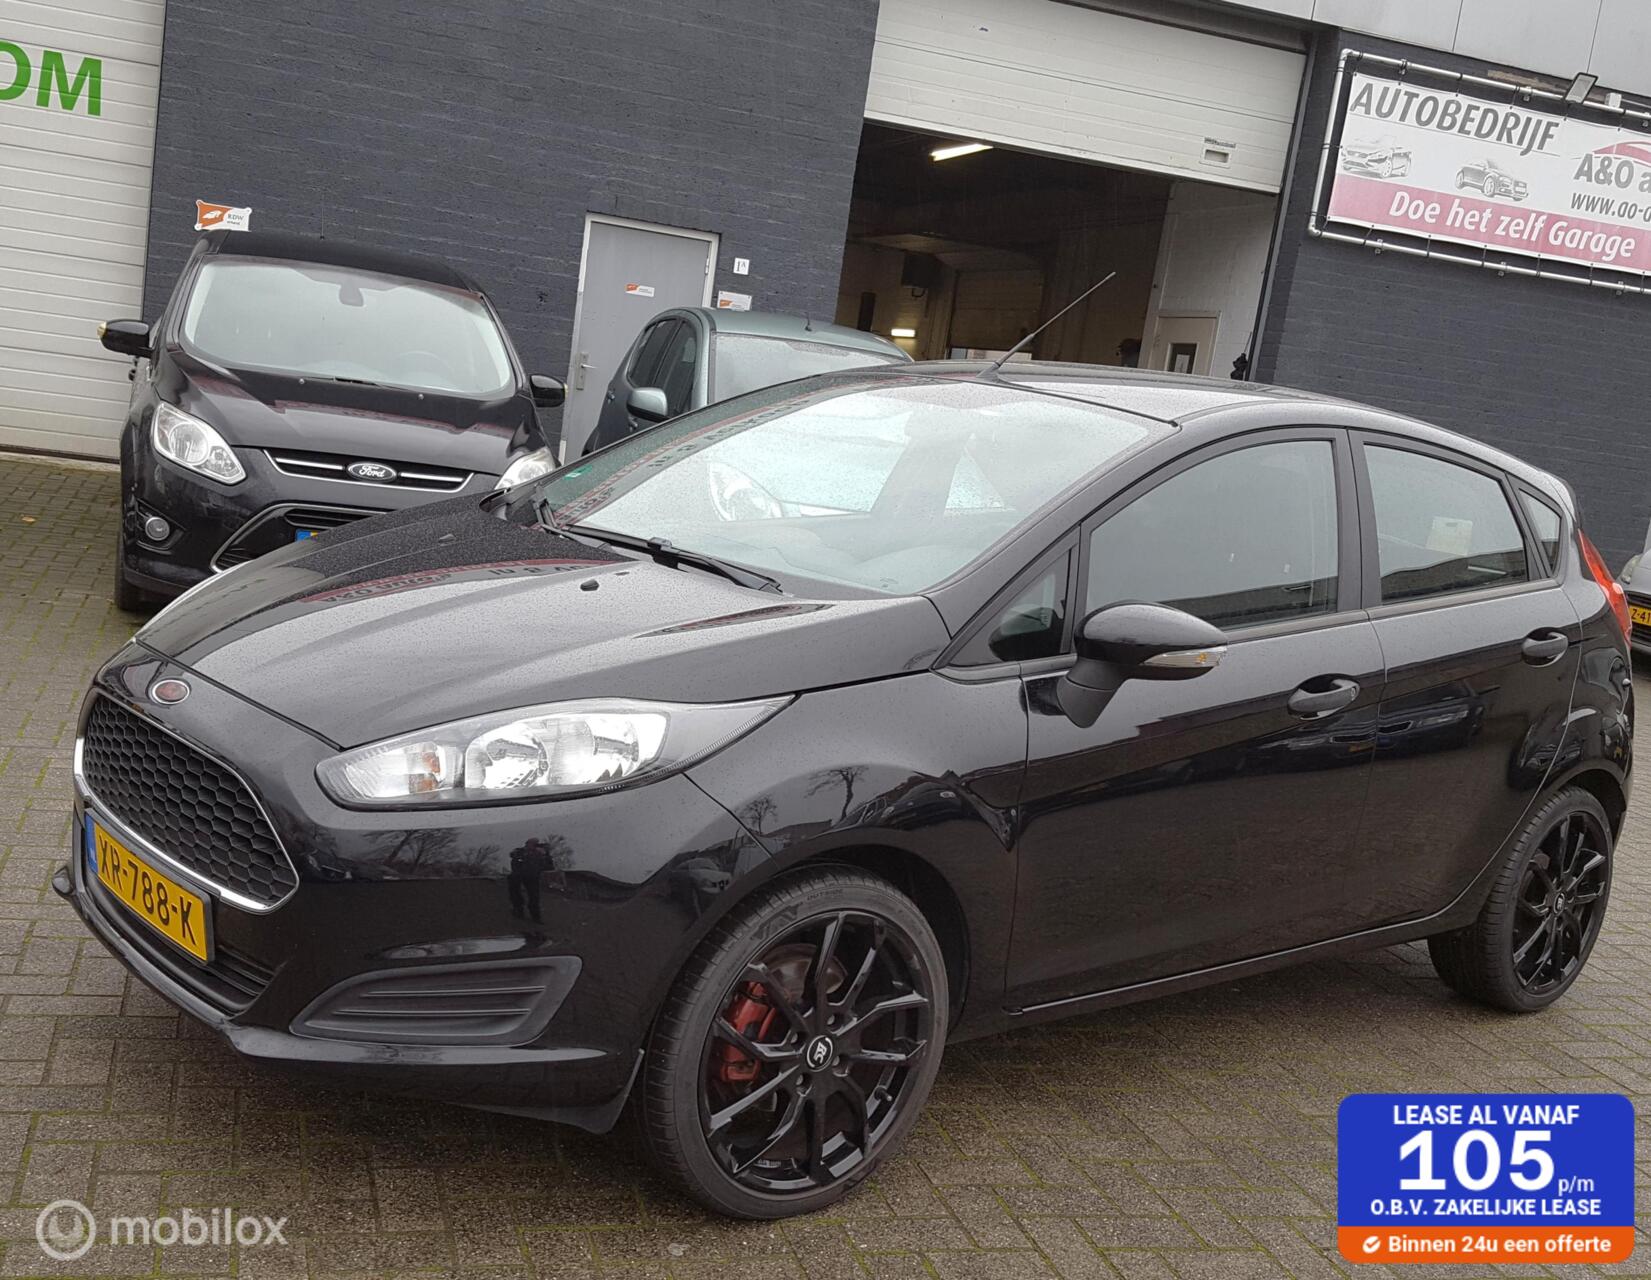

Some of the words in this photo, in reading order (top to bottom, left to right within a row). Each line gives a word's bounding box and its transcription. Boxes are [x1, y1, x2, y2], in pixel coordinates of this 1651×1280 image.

[1349, 82, 1560, 157] AUTOBEDRIJF
[1573, 153, 1635, 188] A&O
[1388, 190, 1440, 224] Doe
[1446, 199, 1492, 233] het
[1495, 212, 1545, 242] zelf
[1549, 220, 1636, 261] Garage
[358, 465, 386, 478] Ford
[98, 833, 197, 947] XR-788-K
